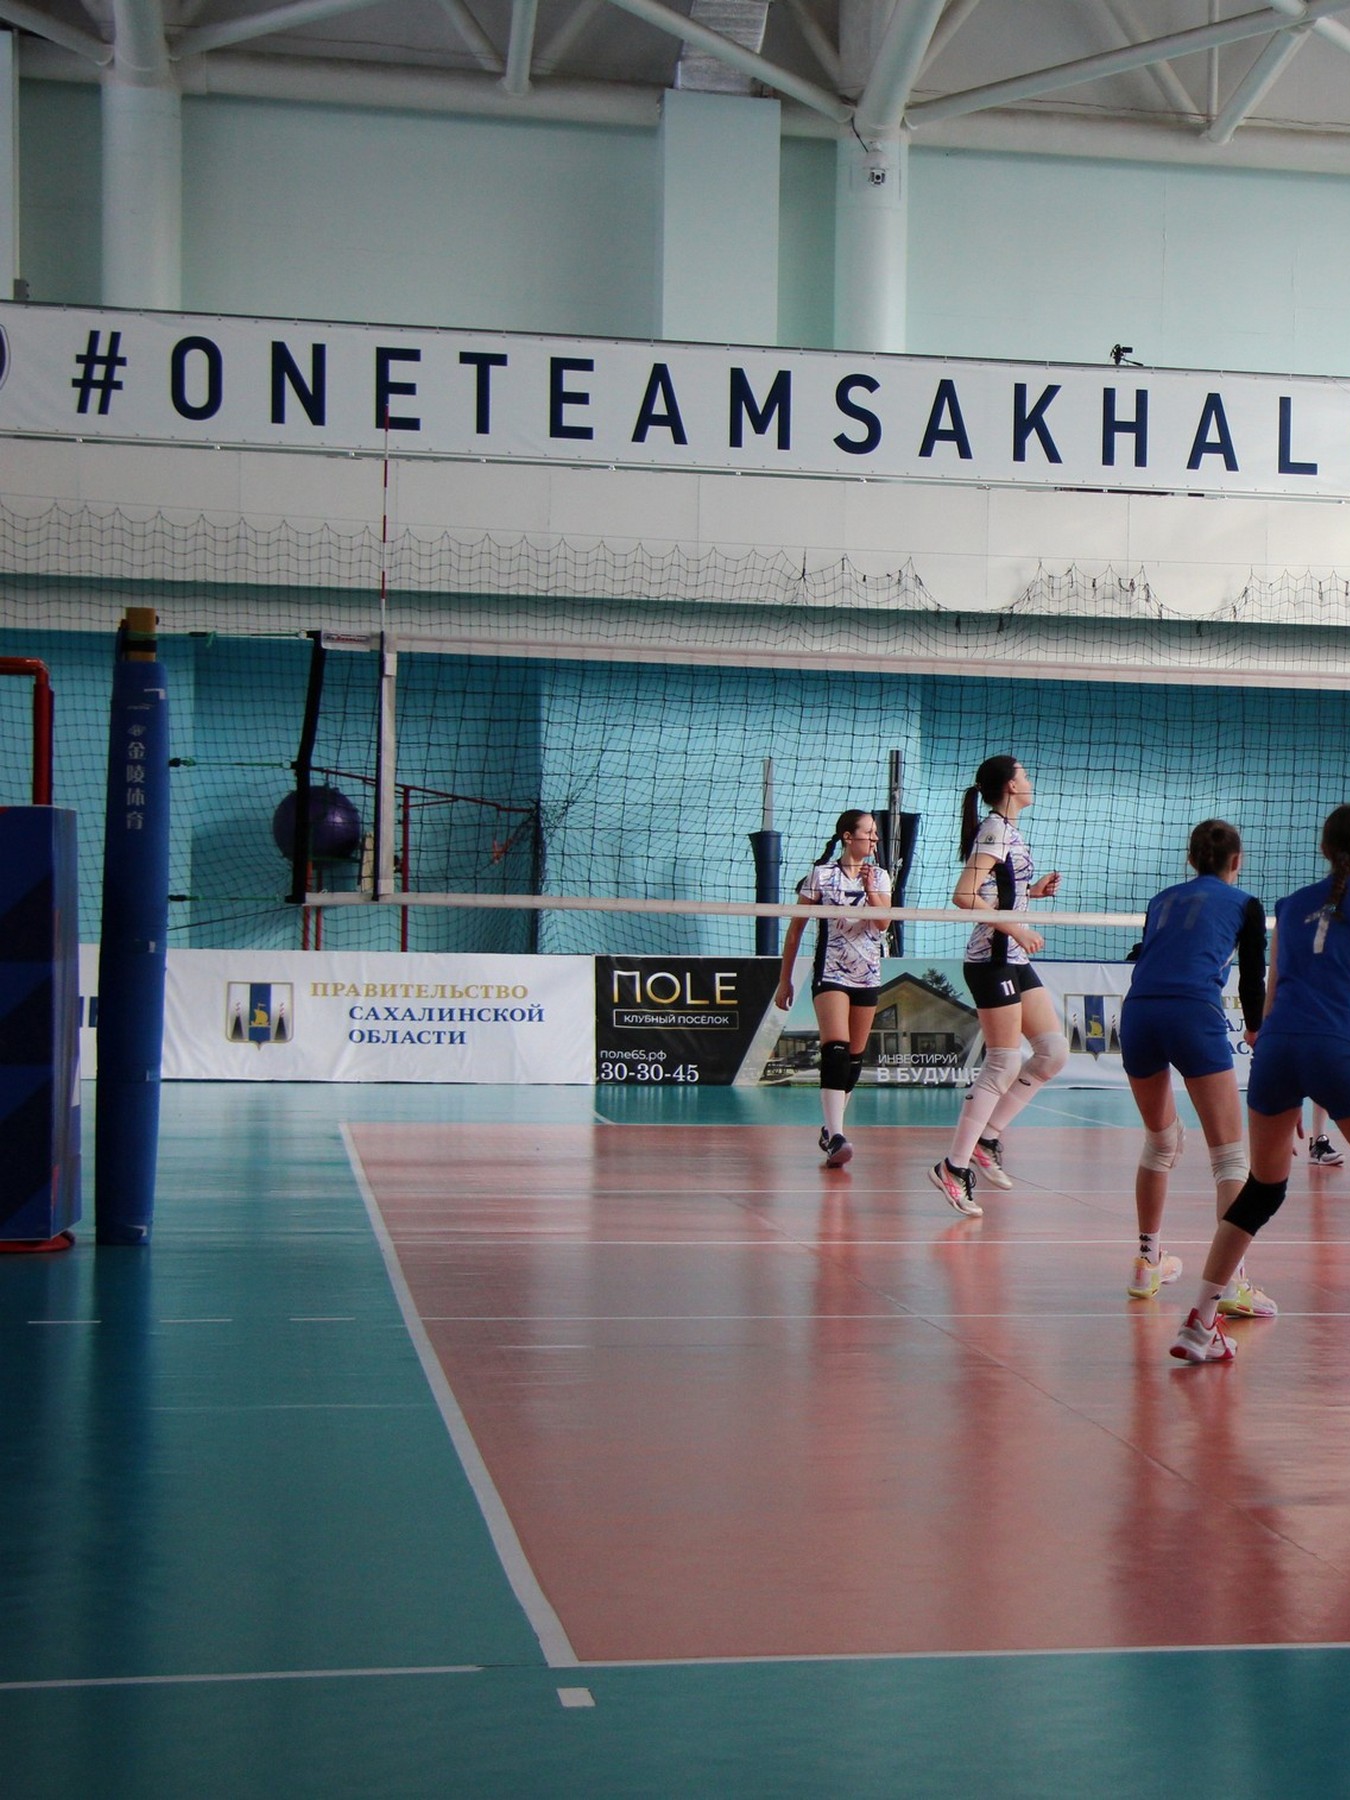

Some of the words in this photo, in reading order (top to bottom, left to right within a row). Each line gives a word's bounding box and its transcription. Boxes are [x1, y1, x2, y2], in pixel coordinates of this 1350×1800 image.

[310, 982, 529, 999] ПРАВИТЕЛЬСТВО
[1000, 979, 1015, 996] 11
[348, 1004, 545, 1022] САХАЛИНСКОЙ
[624, 1014, 677, 1023] КЛУБНЫЙ
[348, 1028, 467, 1045] ОБЛАСТИ
[600, 1050, 667, 1061] поле65.рф
[878, 1053, 958, 1064] ИНВЕСТИРУЙ
[601, 1061, 699, 1082] 30-30-45
[877, 1067, 890, 1082] В
[896, 1067, 981, 1085] БУДУЩЕ
